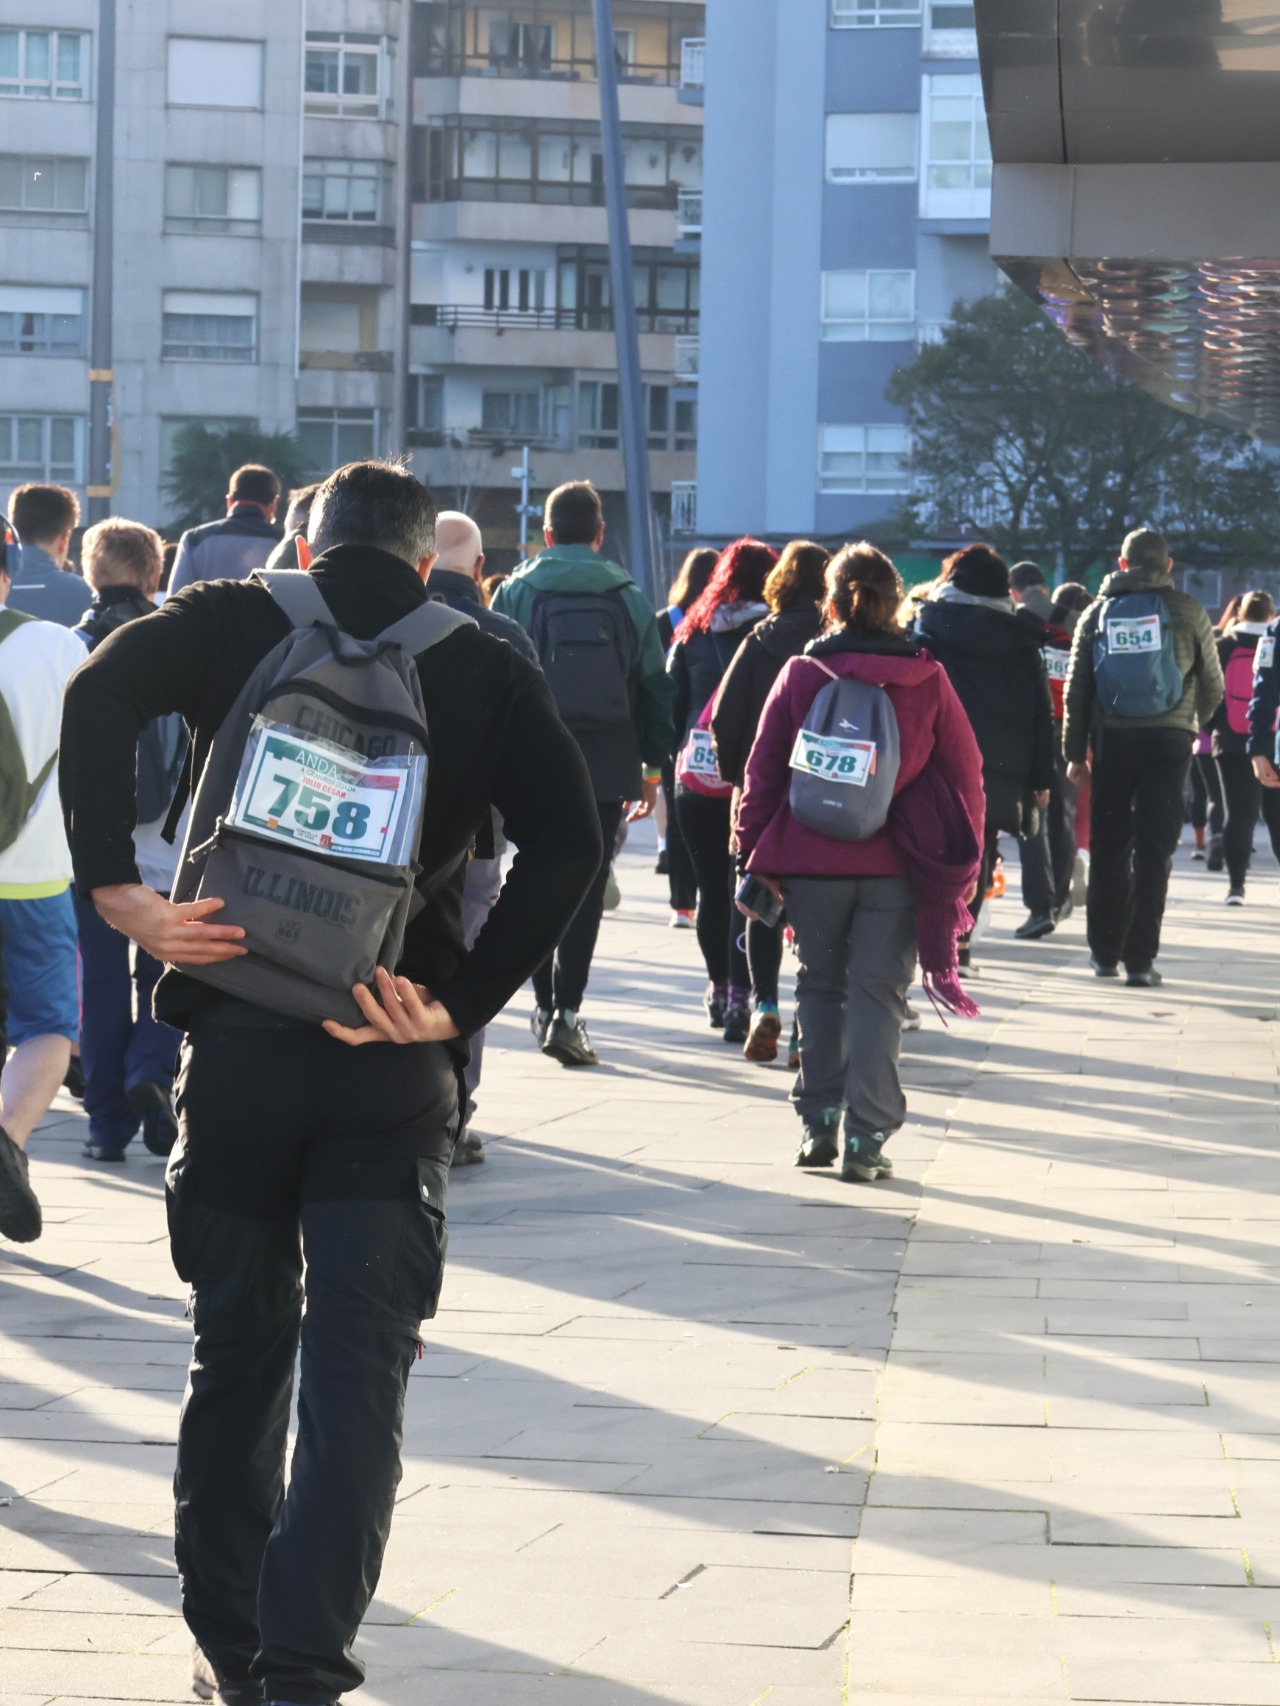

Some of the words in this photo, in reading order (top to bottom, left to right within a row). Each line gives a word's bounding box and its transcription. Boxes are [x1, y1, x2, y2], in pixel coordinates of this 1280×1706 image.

[1115, 629, 1153, 646] 654
[294, 703, 398, 759] CHICAGO
[294, 749, 338, 779] ANDA
[806, 749, 857, 773] 678
[267, 773, 371, 840] 758
[242, 865, 361, 925] ILLINOIS
